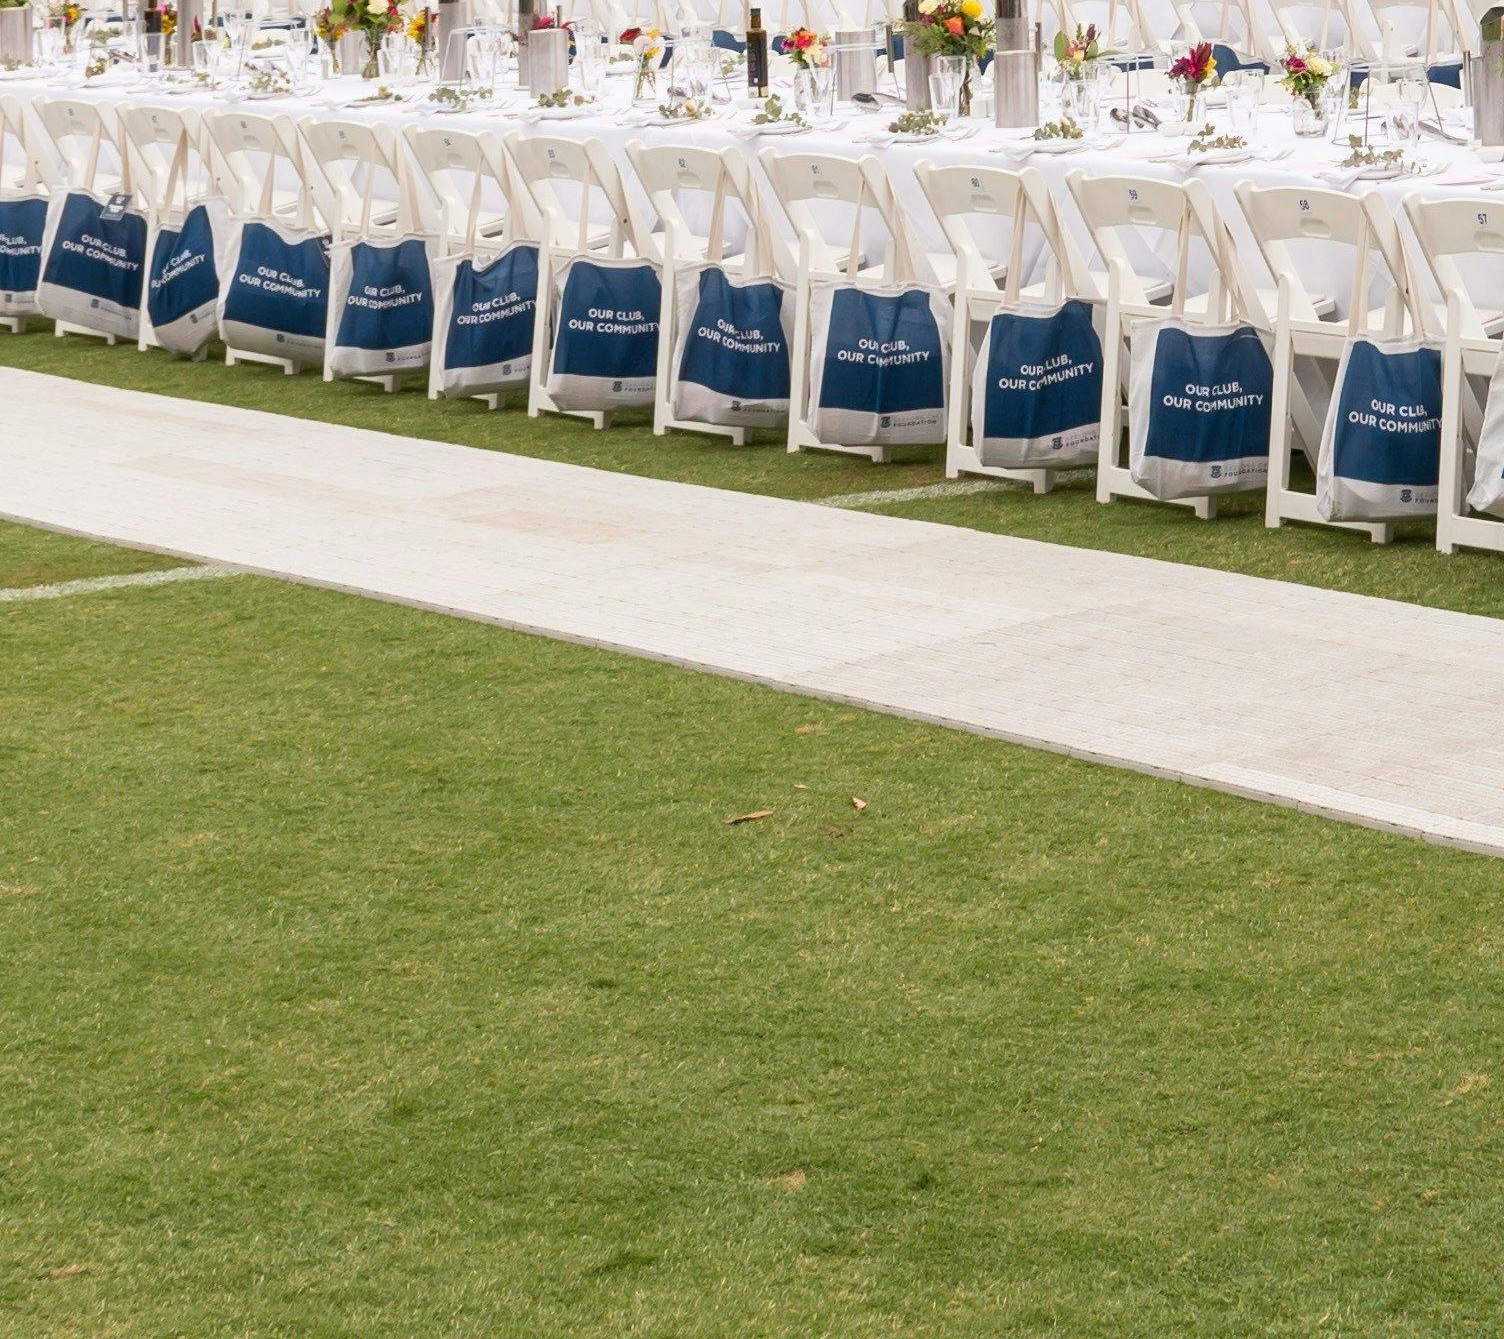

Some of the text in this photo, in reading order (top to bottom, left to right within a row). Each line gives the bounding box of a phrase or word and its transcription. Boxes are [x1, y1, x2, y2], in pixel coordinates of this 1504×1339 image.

[1478, 214, 1487, 225] 57
[588, 308, 613, 321] OUR
[568, 319, 595, 332] OUR
[698, 327, 721, 343] OUR
[837, 350, 864, 363] OUR
[1045, 354, 1073, 371] LUB,
[998, 378, 1026, 389] OUR
[1185, 384, 1210, 398] OUR
[1163, 395, 1192, 410] OUR
[1370, 398, 1395, 416] OUR
[1348, 410, 1377, 427] OUR
